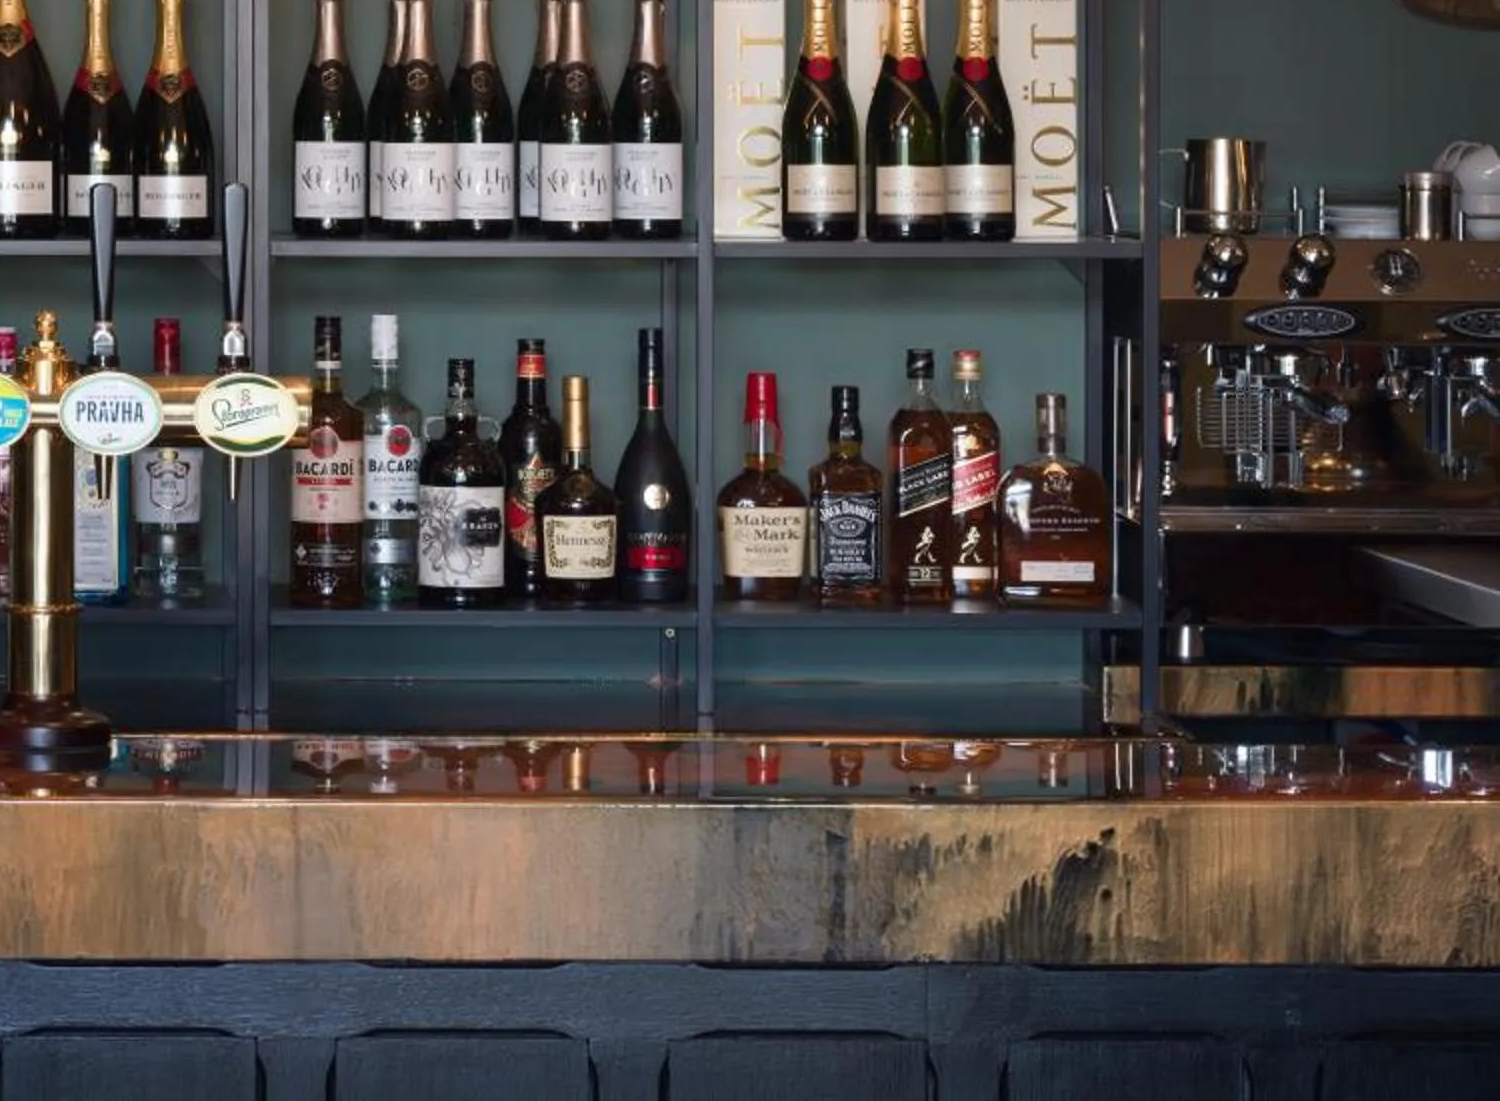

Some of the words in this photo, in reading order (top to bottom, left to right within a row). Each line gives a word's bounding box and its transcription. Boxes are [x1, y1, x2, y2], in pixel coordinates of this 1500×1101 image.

[728, 23, 785, 230] MOËT
[1022, 22, 1077, 230] MOËT
[76, 401, 144, 423] PRAVHA
[734, 514, 801, 526] Maker's
[754, 529, 801, 541] Mark
